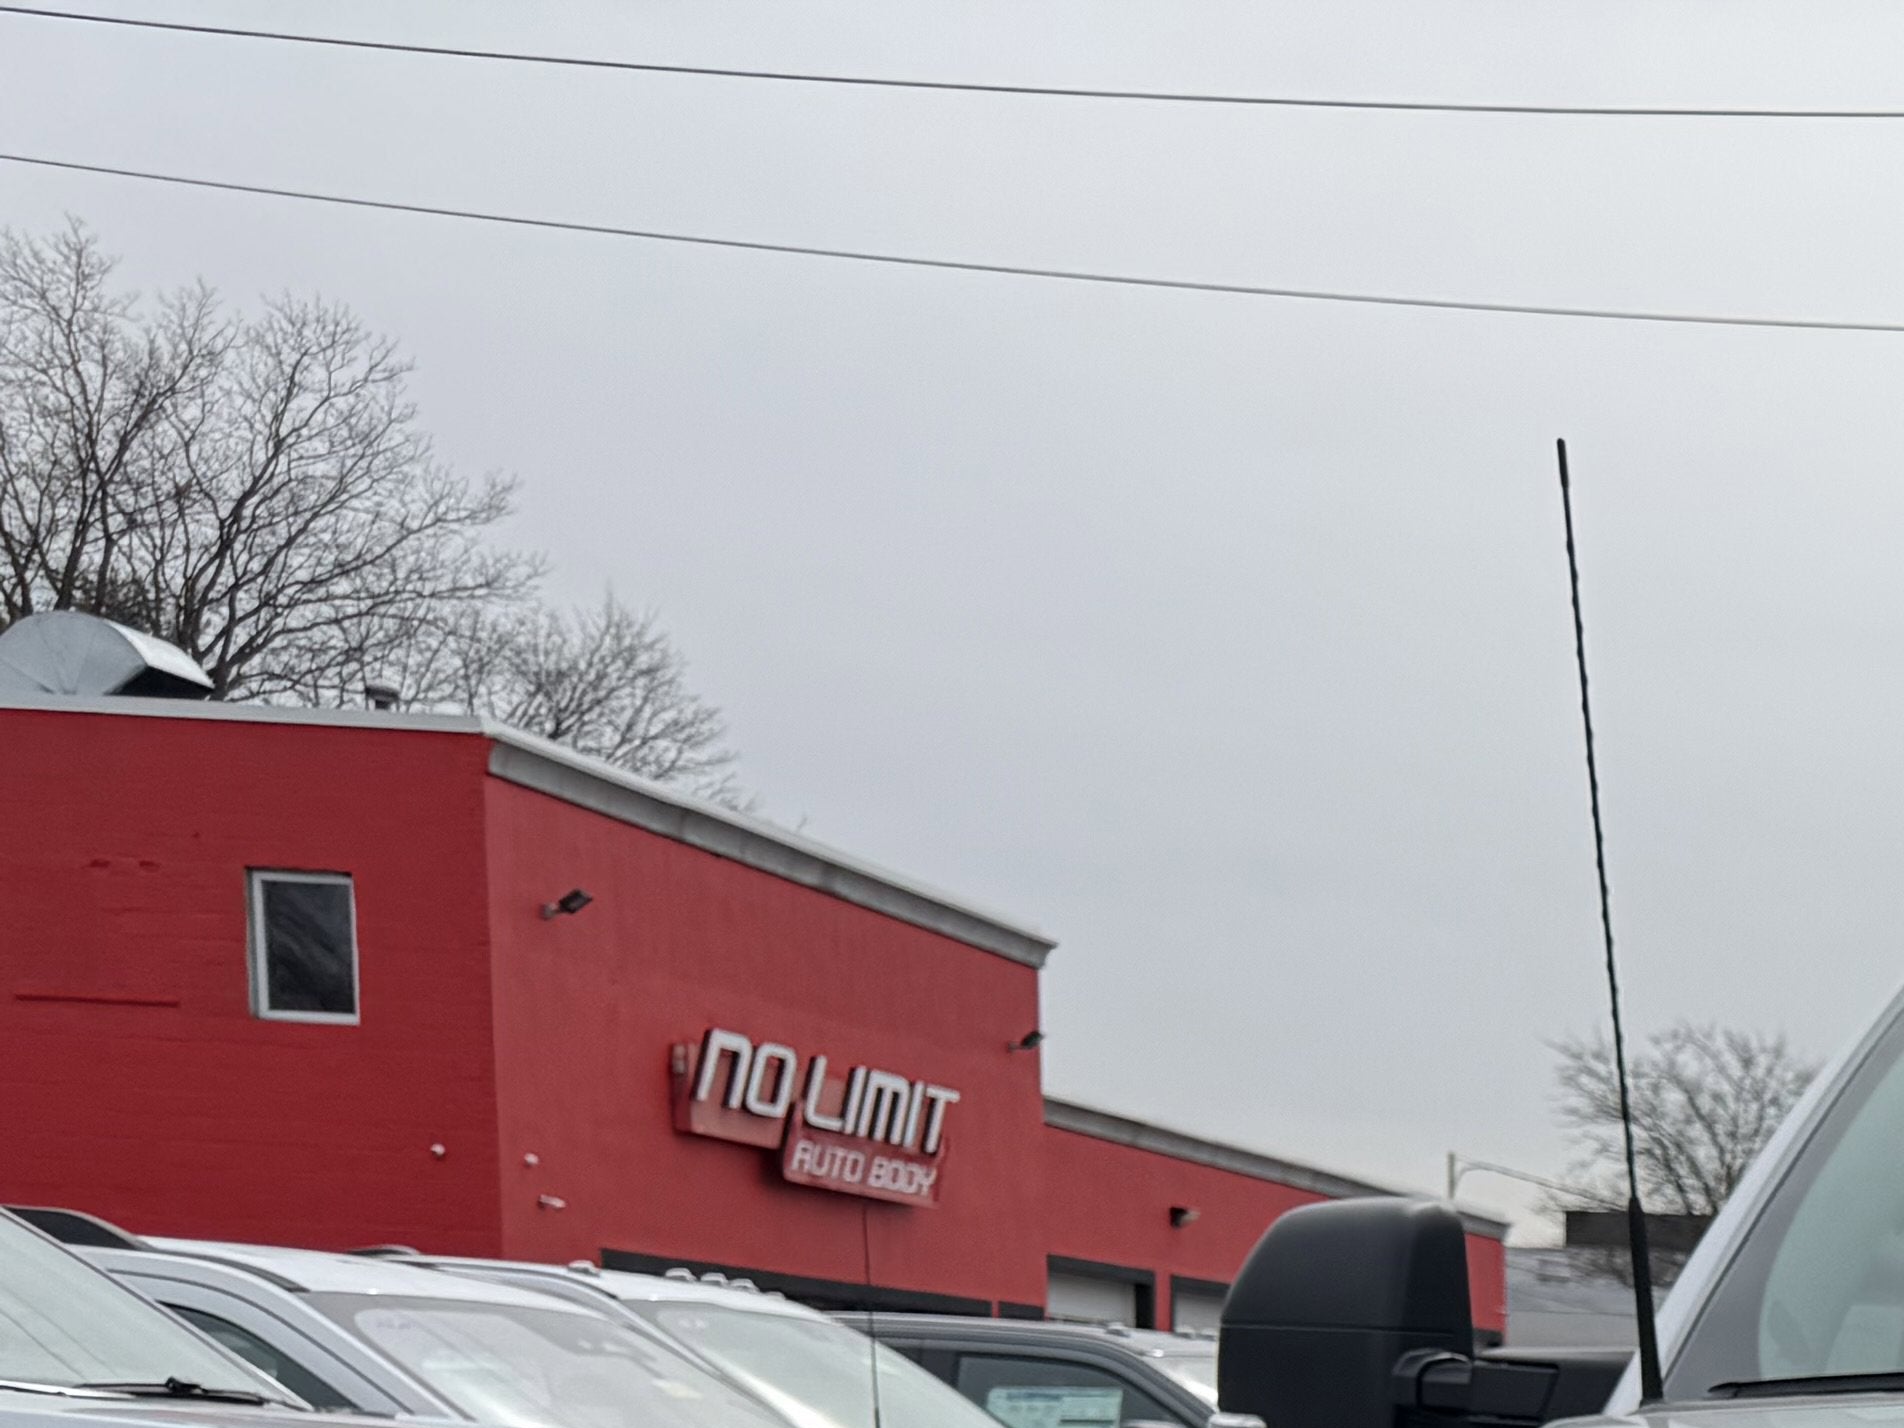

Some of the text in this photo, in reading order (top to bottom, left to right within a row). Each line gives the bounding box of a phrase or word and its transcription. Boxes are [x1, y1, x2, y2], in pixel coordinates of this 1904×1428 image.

[697, 1028, 960, 1154] NO LIMIT
[791, 1139, 938, 1196] AUTO BODY
